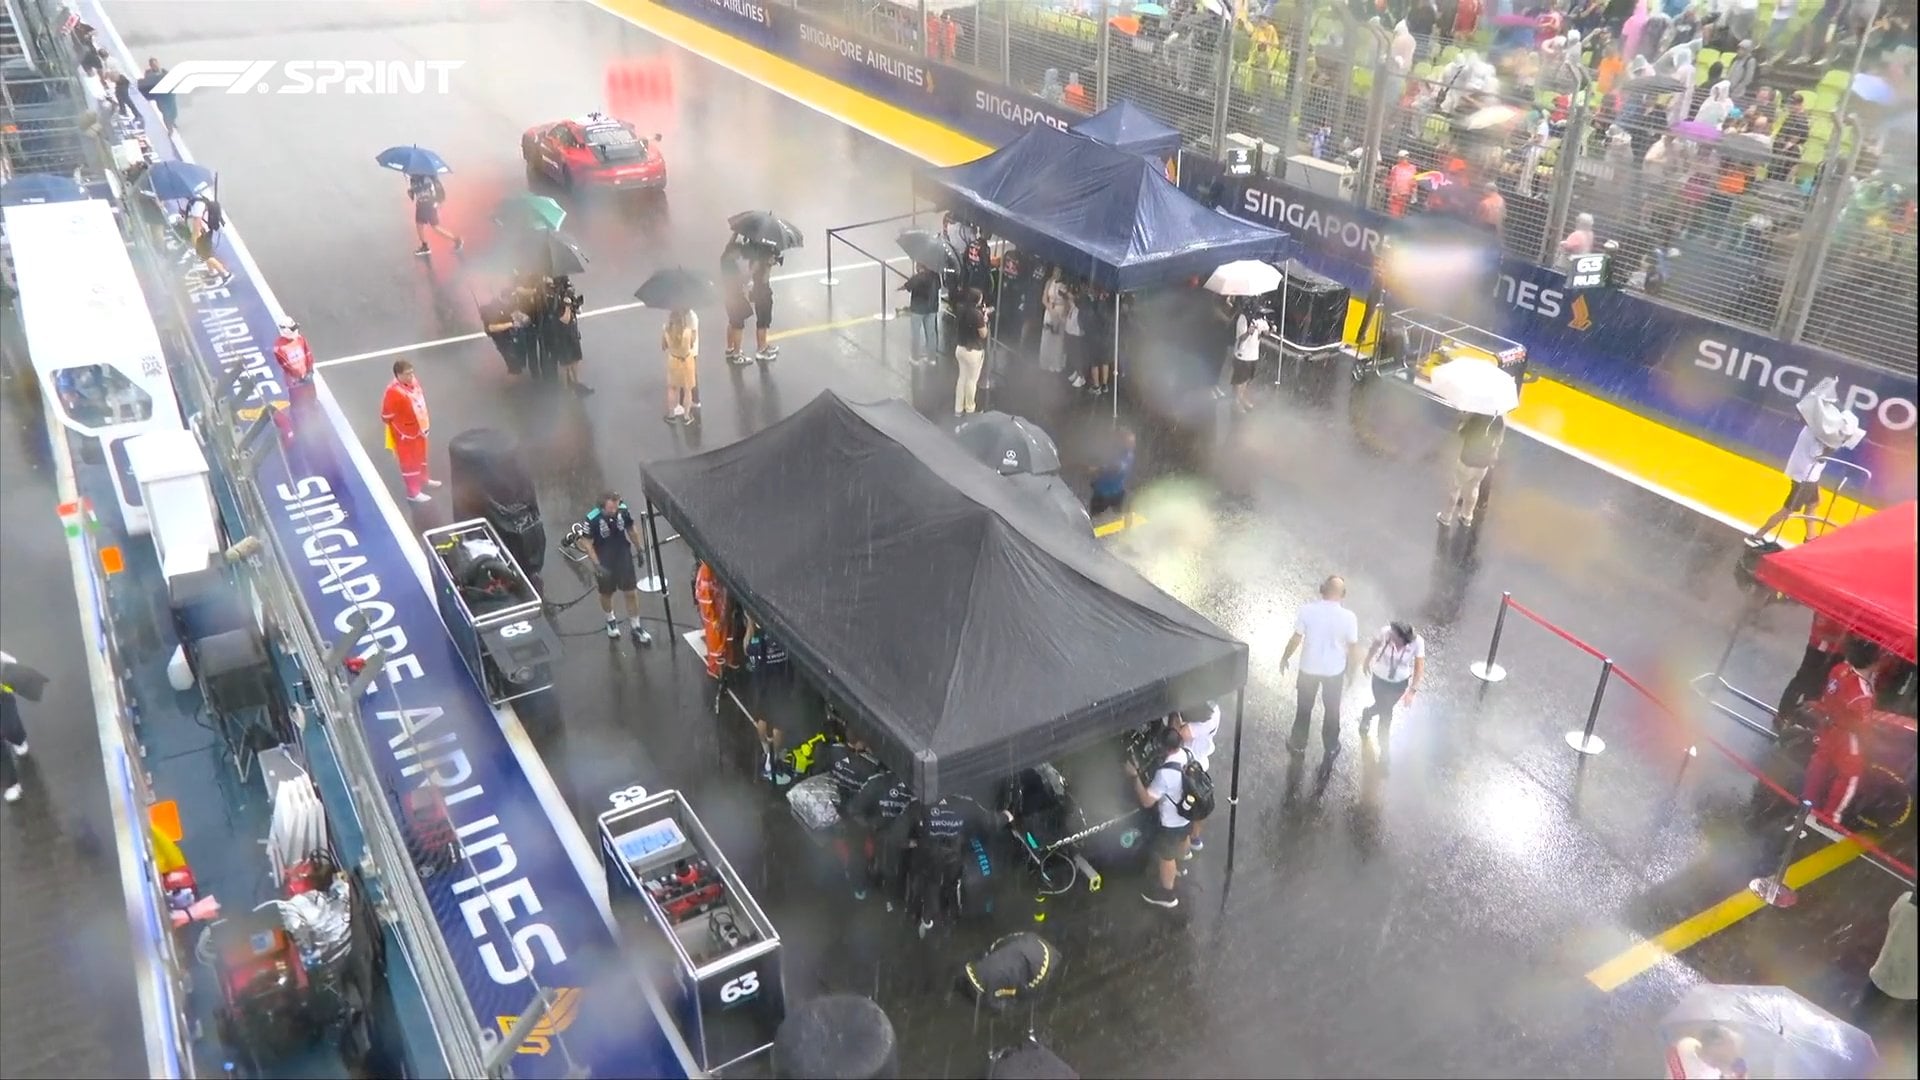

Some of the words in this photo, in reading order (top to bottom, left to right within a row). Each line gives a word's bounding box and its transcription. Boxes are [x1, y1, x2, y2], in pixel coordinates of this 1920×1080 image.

[799, 23, 862, 63] SINGAPORE
[866, 51, 924, 86] AIRLINES
[1244, 188, 1382, 252] SINGAPOR
[1576, 256, 1603, 273] 63
[1694, 339, 1917, 431] SINGPO
[276, 475, 426, 695] SINGAPORE
[500, 620, 533, 638] 63
[720, 970, 760, 1003] 63
